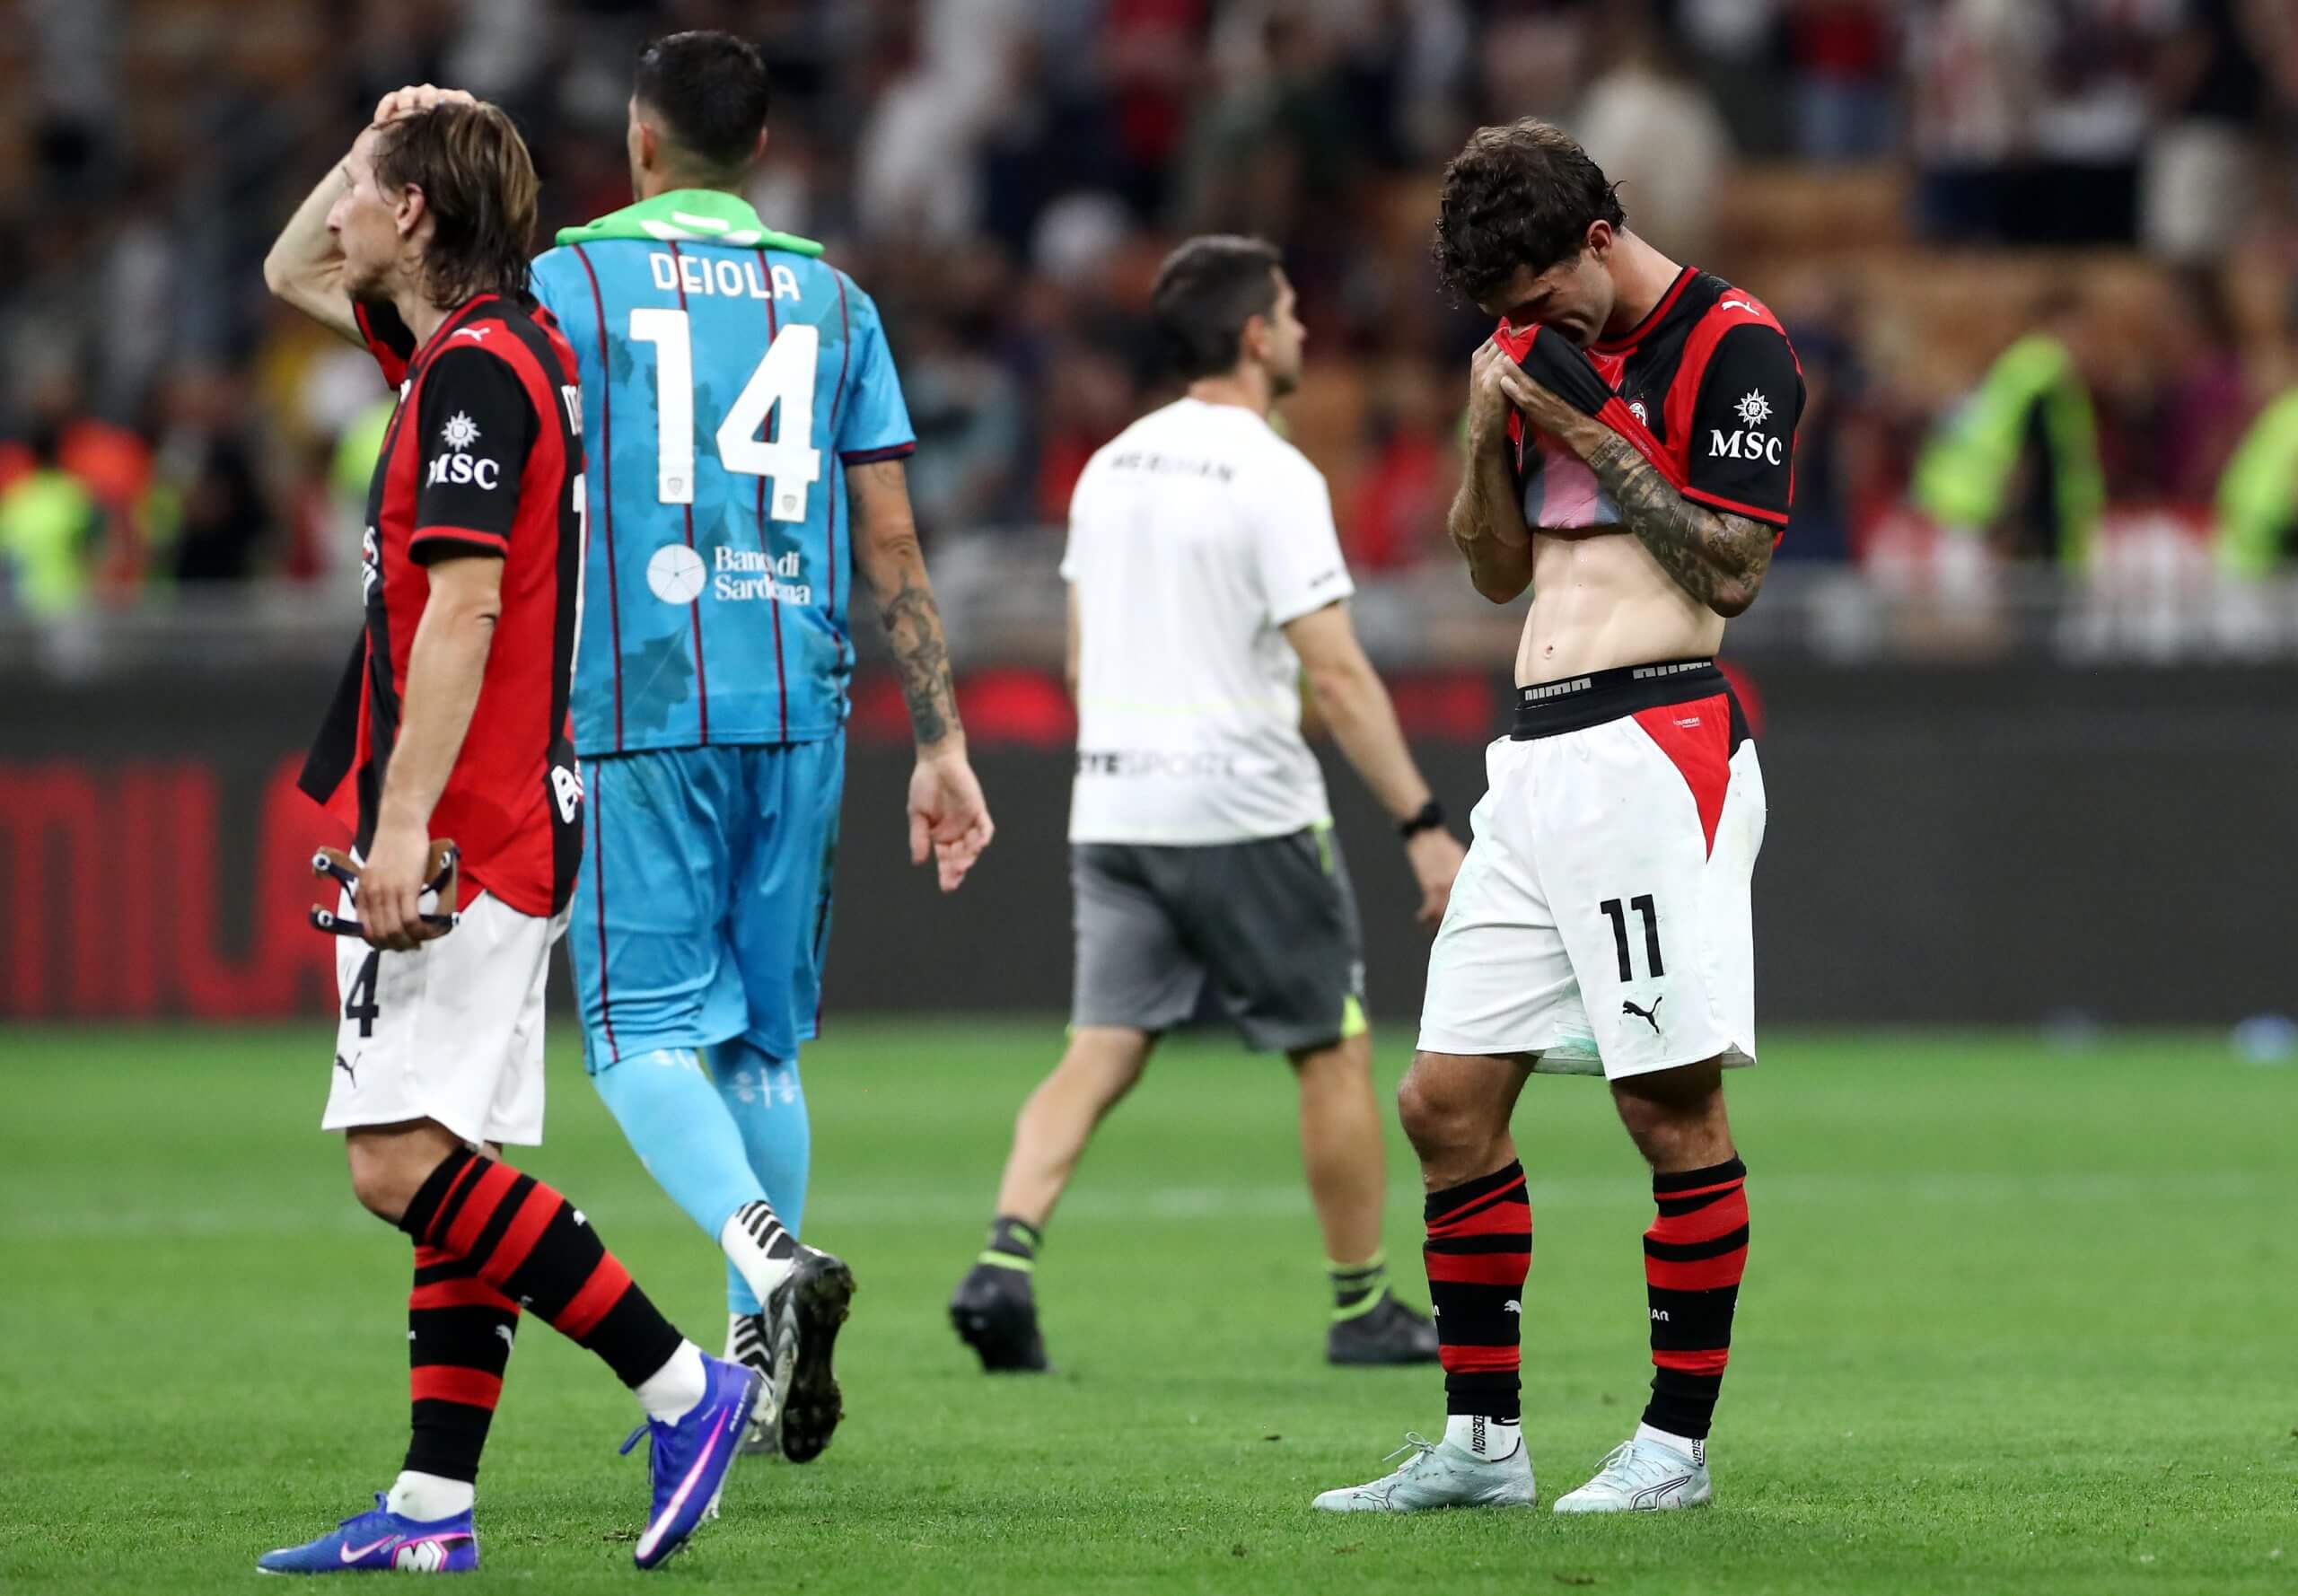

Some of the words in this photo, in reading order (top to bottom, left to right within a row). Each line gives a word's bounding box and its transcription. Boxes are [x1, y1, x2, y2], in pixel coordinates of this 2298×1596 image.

[649, 252, 801, 302] DEIOLA
[630, 308, 820, 523] 14
[1708, 429, 1782, 466] MSC
[426, 453, 500, 490] MSC
[777, 551, 800, 577] di
[0, 752, 341, 1020] MILA
[1601, 894, 1664, 982] 11
[1472, 1416, 1486, 1455] DESIGN
